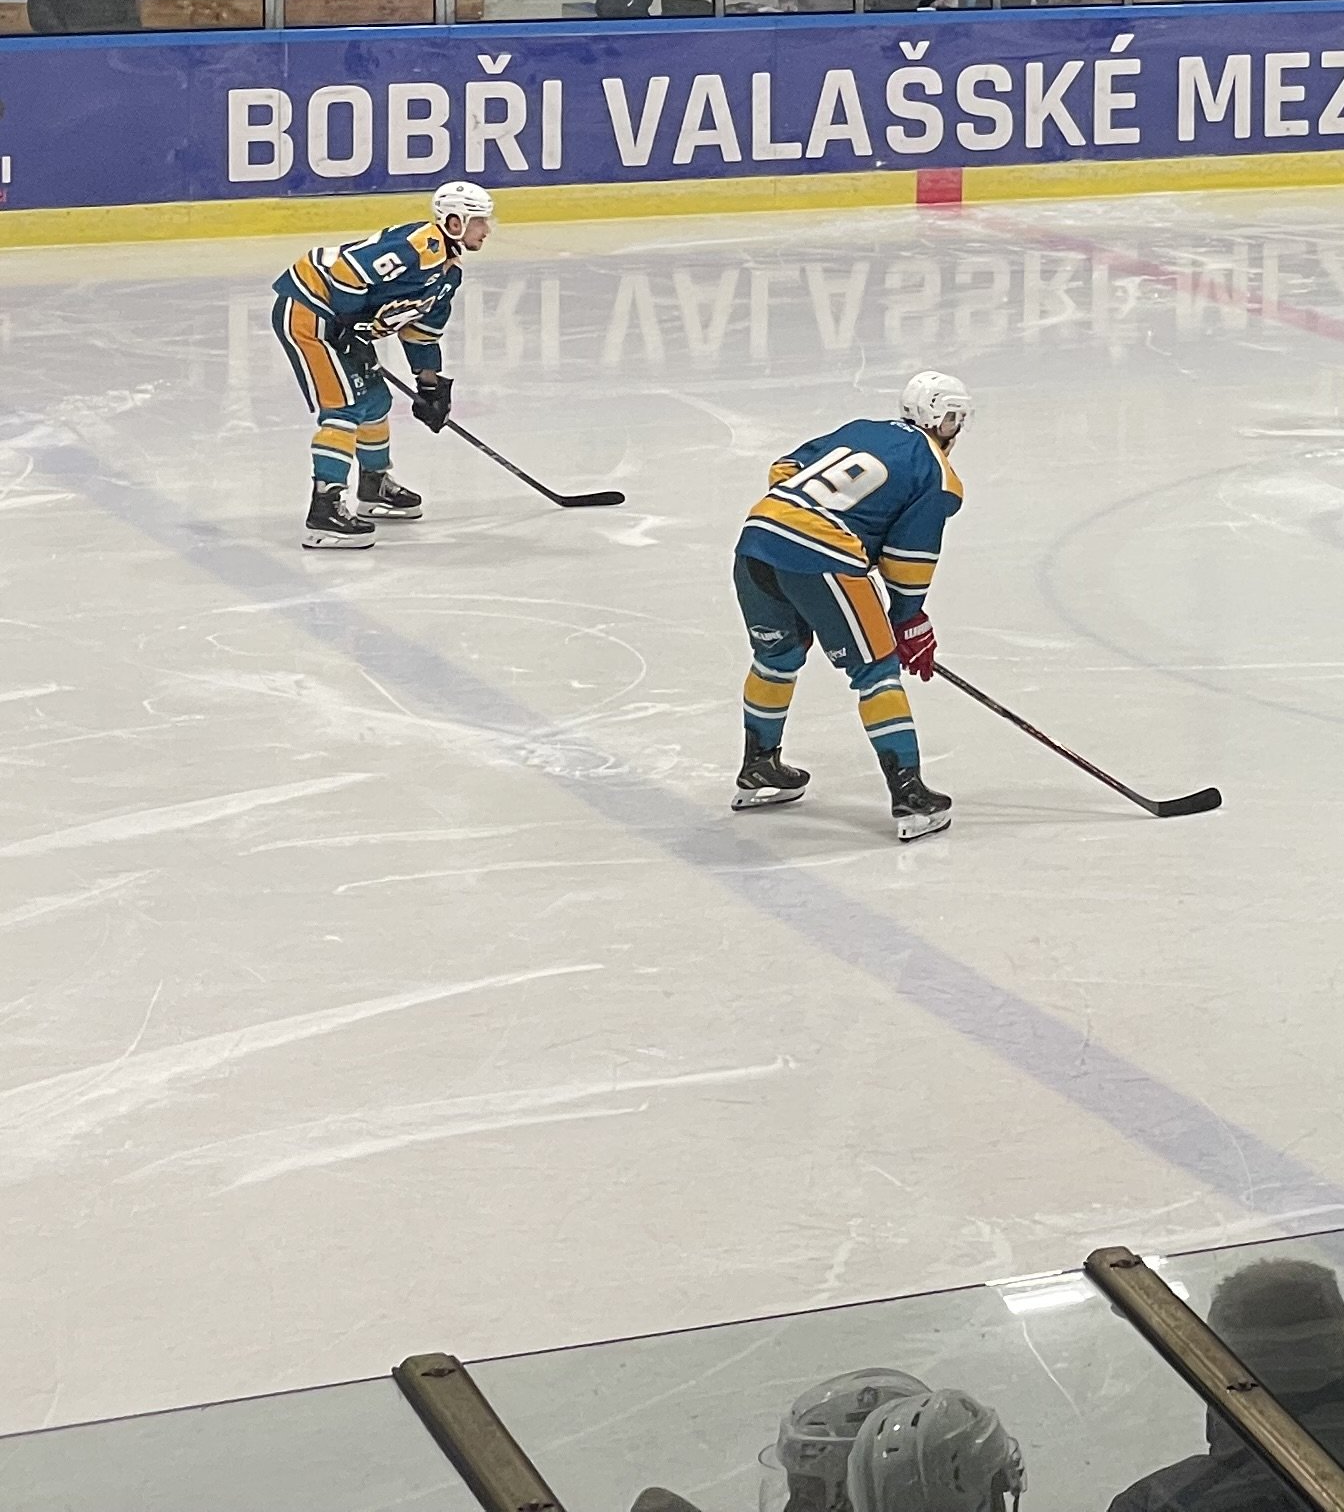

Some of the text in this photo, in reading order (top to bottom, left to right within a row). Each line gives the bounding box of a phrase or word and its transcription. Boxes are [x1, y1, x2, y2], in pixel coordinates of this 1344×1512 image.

[228, 54, 563, 182] BOBŘI
[600, 34, 1141, 166] VALAŠSKÉ
[777, 446, 889, 512] 19
